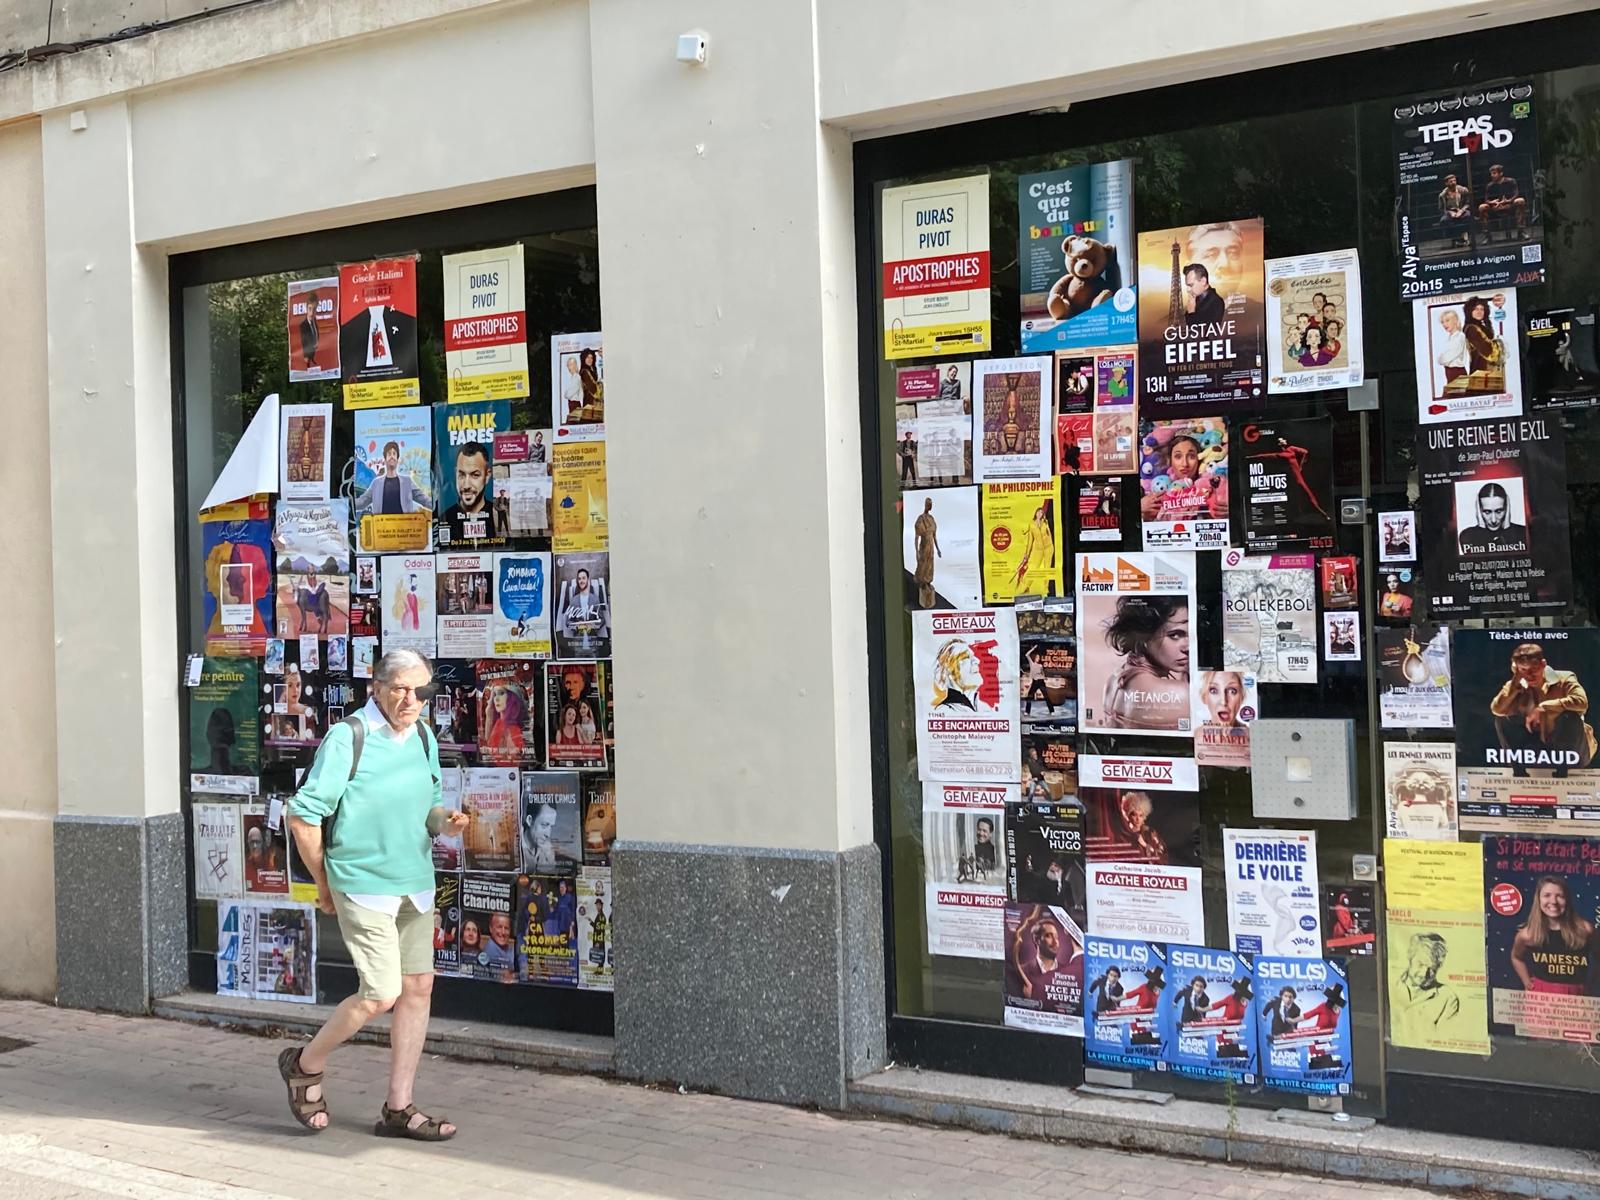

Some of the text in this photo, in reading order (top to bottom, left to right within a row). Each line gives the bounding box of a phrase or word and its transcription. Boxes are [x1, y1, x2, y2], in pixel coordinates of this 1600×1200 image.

[1418, 115, 1494, 144] TEBAS
[1037, 196, 1070, 213] que
[916, 207, 954, 227] DURAS
[1047, 209, 1070, 224] du
[1029, 219, 1104, 240] bonheur
[919, 230, 951, 249] PIVOT
[1402, 246, 1420, 278] Alya
[1425, 253, 1516, 272] Première fois à Avignon
[352, 269, 404, 284] Gisèle Halimi
[892, 257, 980, 285] APOSTROPHES
[470, 272, 499, 289] DURAS
[1402, 278, 1443, 294] 20h15
[472, 292, 497, 309] PIVOT
[1111, 314, 1135, 326] 17H45
[1530, 317, 1554, 331] ÉVEIL
[452, 316, 519, 340] APOSTROPHES
[1164, 320, 1236, 341] GUSTAVE
[1165, 338, 1237, 365] EIFFEL
[1196, 362, 1216, 371] CONTRE
[1145, 376, 1167, 393] 13H
[447, 412, 497, 432] MALIK
[450, 427, 494, 446] FARES
[1428, 420, 1550, 450] UNE REINE EN EXIL
[1458, 453, 1466, 462] de
[1466, 450, 1495, 462] Jean-Paul
[1495, 448, 1521, 459] Chabrier
[1249, 463, 1264, 476] MO
[989, 480, 1054, 494] MA PHILOSOPHIE
[1249, 474, 1287, 490] MENTOS
[1163, 495, 1207, 510] FILLE UNIQUE
[470, 523, 486, 535] PARIS
[1199, 532, 1222, 542] 20h40
[1463, 541, 1526, 554] Pina Bausch
[448, 559, 481, 568] GEMEAUX
[1082, 575, 1091, 583] LA
[1507, 580, 1527, 590] Avignon
[1082, 583, 1114, 592] FACTORY
[1226, 599, 1313, 612] ROLLEKEBOL
[223, 625, 252, 634] NORMAL
[933, 617, 996, 630] GEMEAUX
[1489, 631, 1569, 641] Tête-à-tête avec
[1287, 656, 1309, 666] 17H45
[211, 671, 245, 684] peintre
[1124, 690, 1182, 704] MÉTANOÏA
[928, 720, 1010, 731] LES ENCHANTEURS
[968, 734, 995, 742] Malavoy
[1399, 751, 1423, 759] FEMMES
[1485, 748, 1580, 765] RIMBAUD
[966, 766, 974, 774] 04
[1102, 765, 1173, 779] GEMEAUX
[528, 793, 577, 804] D'ALBERT CAMUS
[943, 790, 1007, 804] GEMEAUX
[1389, 811, 1397, 829] Alya
[1040, 826, 1081, 841] VICTOR
[1049, 839, 1082, 850] HUGO
[1235, 840, 1307, 863] DERRIÈRE
[1114, 864, 1162, 874] Catherine Jacob
[1238, 863, 1303, 882] LE VOILE
[1097, 873, 1185, 890] AGATHE ROYALE
[463, 893, 511, 912] Charlotte
[938, 892, 960, 904] L'AMI
[961, 894, 974, 904] DU
[529, 923, 543, 935] ÇA
[1137, 923, 1147, 932] 04
[523, 934, 568, 945] TROMPE
[240, 914, 253, 985] MONSTRES
[437, 949, 457, 961] 17H15
[1087, 941, 1149, 964] SEUL(S)
[1171, 950, 1236, 974] SEUL(S)
[1532, 952, 1588, 967] VANESSA
[1054, 971, 1076, 981] Pierre
[1257, 961, 1327, 982] SEUL(S)
[1548, 963, 1575, 976] DIEU
[1044, 985, 1082, 996] FACE AU
[1046, 992, 1080, 1004] PEUPLE
[1094, 1025, 1123, 1035] KARIM
[1178, 1036, 1209, 1047] KARIM
[1087, 1051, 1156, 1067] LA PETITE CASERNE
[1270, 1050, 1301, 1060] KARIM
[1171, 1063, 1243, 1080] LA PETITE CASERNE
[1265, 1077, 1337, 1091] LA PETITE CASERNE
